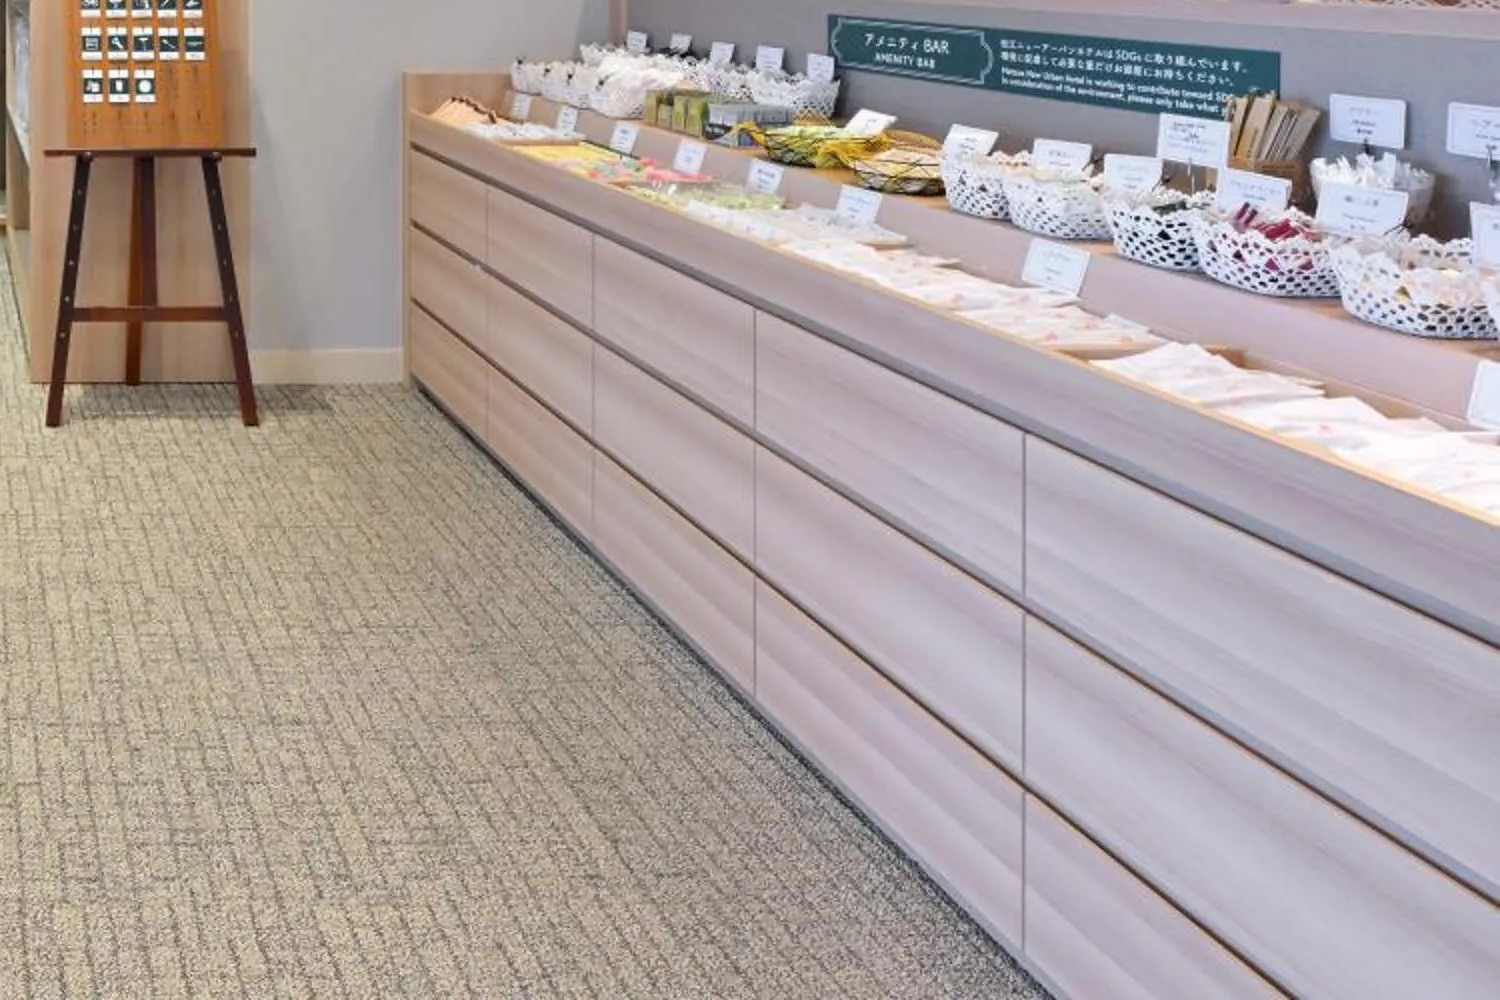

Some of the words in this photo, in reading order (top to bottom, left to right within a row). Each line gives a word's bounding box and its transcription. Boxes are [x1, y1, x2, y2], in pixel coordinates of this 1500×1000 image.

[864, 32, 919, 51] アメニティ
[923, 38, 949, 55] BAR
[875, 52, 914, 66] AMENITY
